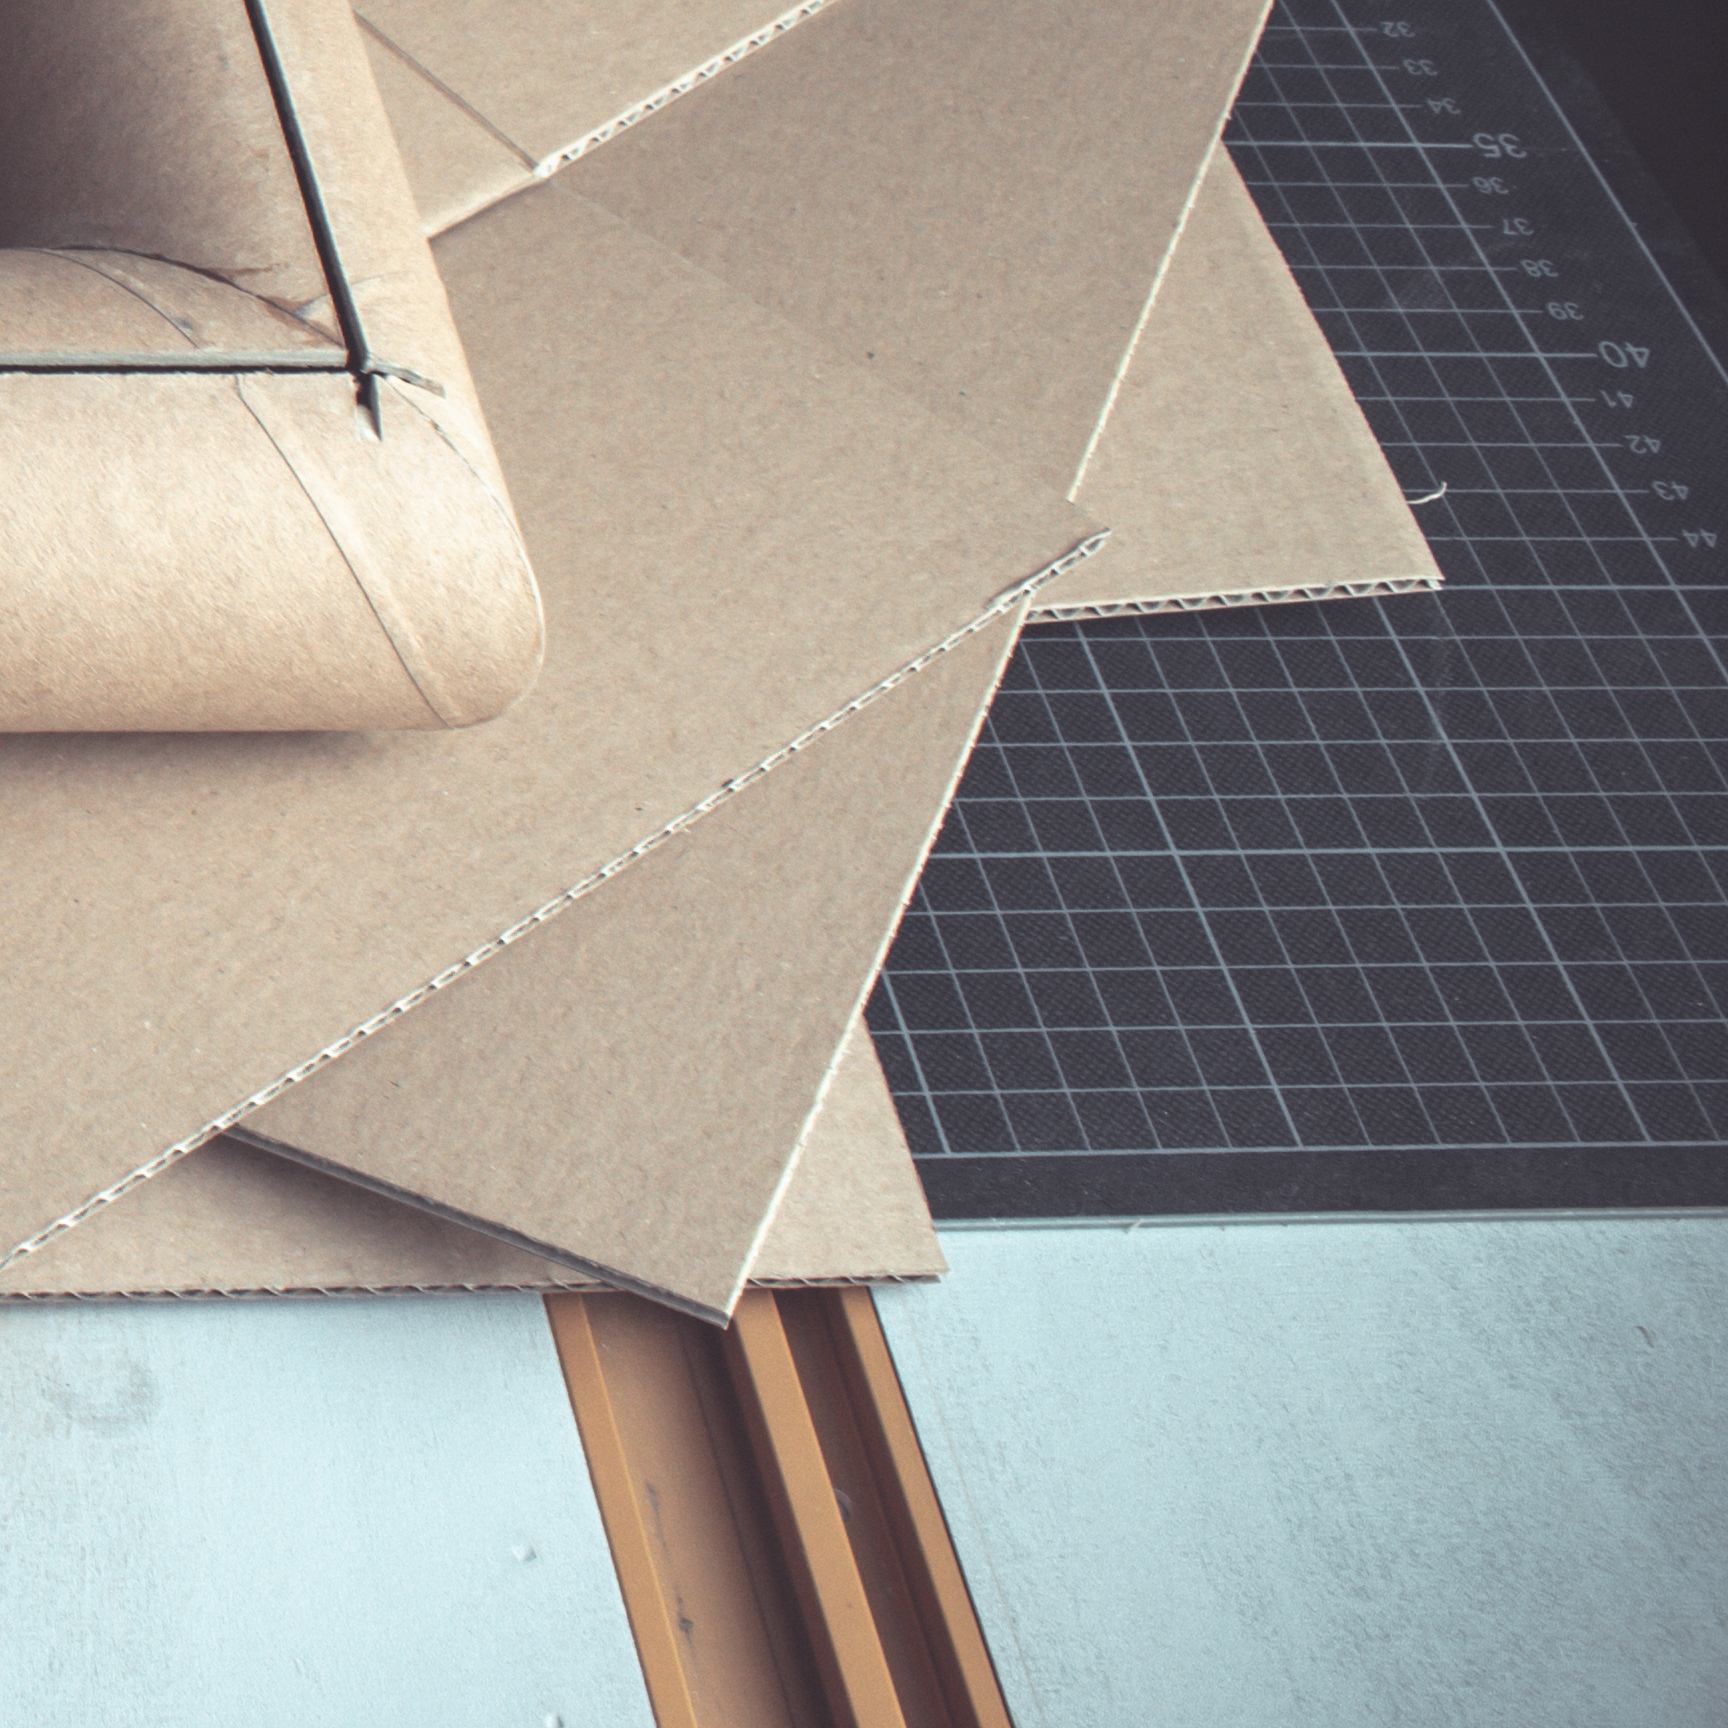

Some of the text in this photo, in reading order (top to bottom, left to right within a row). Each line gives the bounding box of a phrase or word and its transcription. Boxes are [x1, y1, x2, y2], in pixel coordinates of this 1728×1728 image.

[1381, 21, 1416, 37] 32
[1403, 59, 1438, 76] 33
[1426, 97, 1461, 115] 34
[1472, 132, 1528, 159] 35
[1472, 176, 1509, 194] 36
[1502, 218, 1534, 236] 37
[1520, 259, 1558, 278] 38
[1546, 301, 1584, 320] 39
[1598, 340, 1650, 369] 40
[1600, 390, 1634, 409] 41
[1624, 434, 1661, 454] 42
[1651, 480, 1690, 501] 43
[1682, 528, 1717, 548] 44
